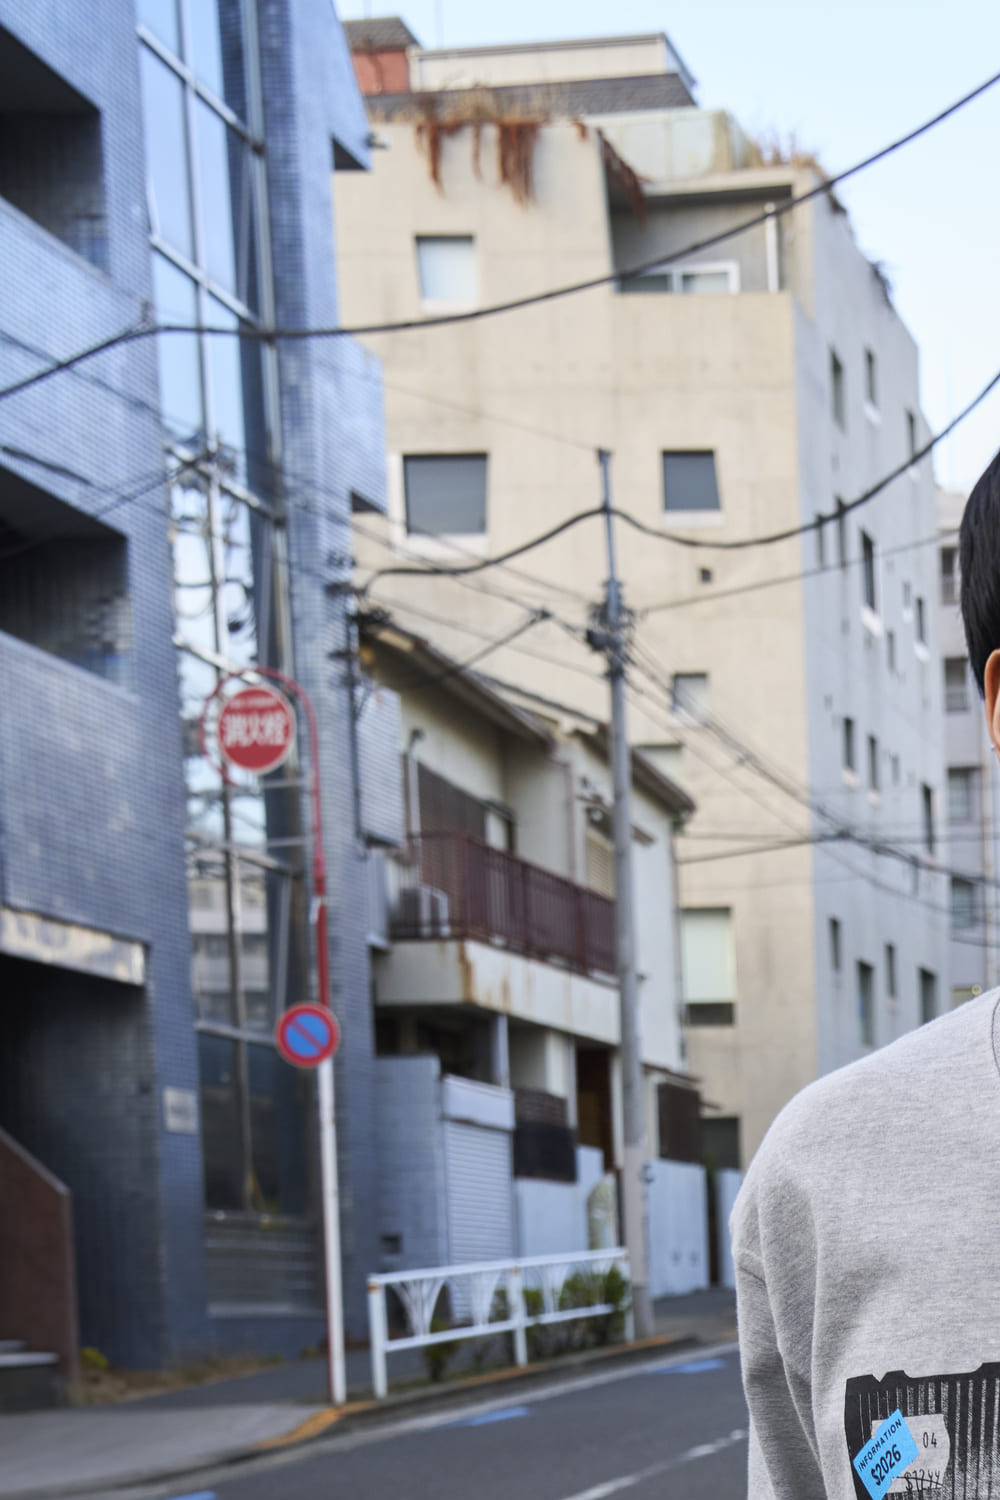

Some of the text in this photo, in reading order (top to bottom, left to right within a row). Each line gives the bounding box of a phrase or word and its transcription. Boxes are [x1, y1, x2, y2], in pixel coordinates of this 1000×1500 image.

[226, 712, 285, 747] 消火栓
[858, 1418, 902, 1472] INFORMATION
[923, 1431, 937, 1448] 04
[870, 1443, 902, 1486] $2026
